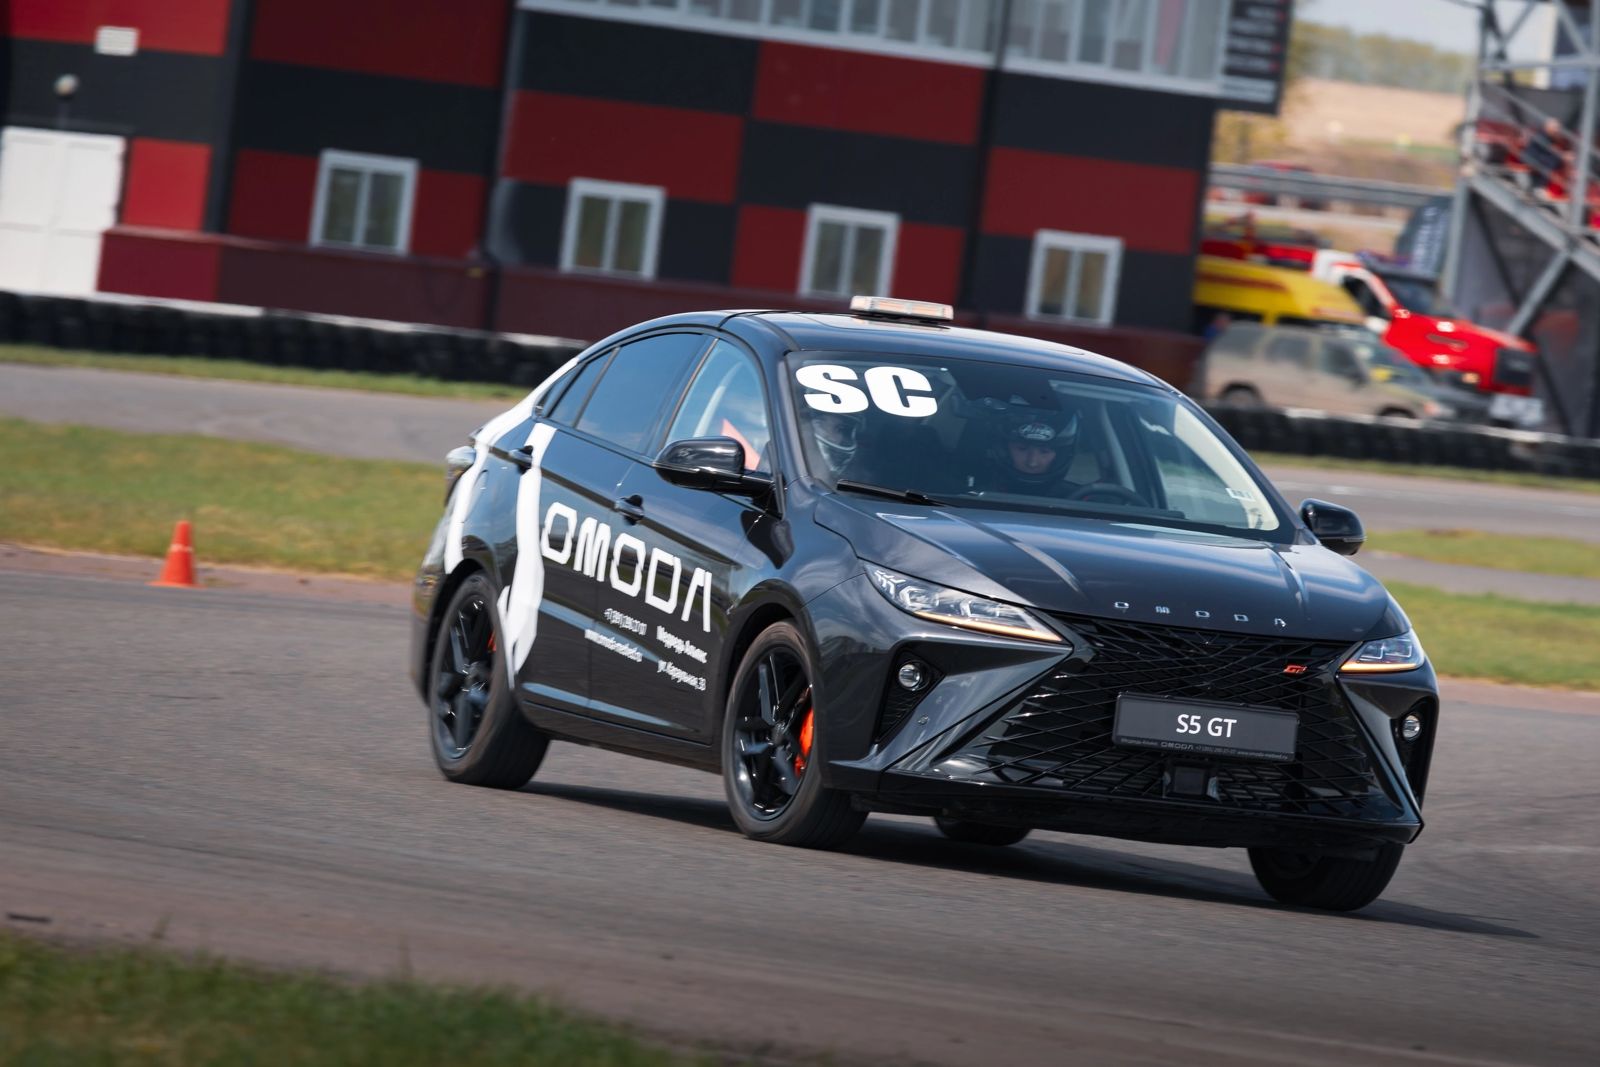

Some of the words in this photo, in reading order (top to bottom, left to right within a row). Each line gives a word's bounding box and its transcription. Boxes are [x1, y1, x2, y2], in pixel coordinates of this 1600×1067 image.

[796, 364, 938, 418] SC
[540, 501, 713, 633] OMODA
[1113, 601, 1288, 628] OMODA
[1175, 713, 1201, 735] S5
[1207, 717, 1238, 738] GT
